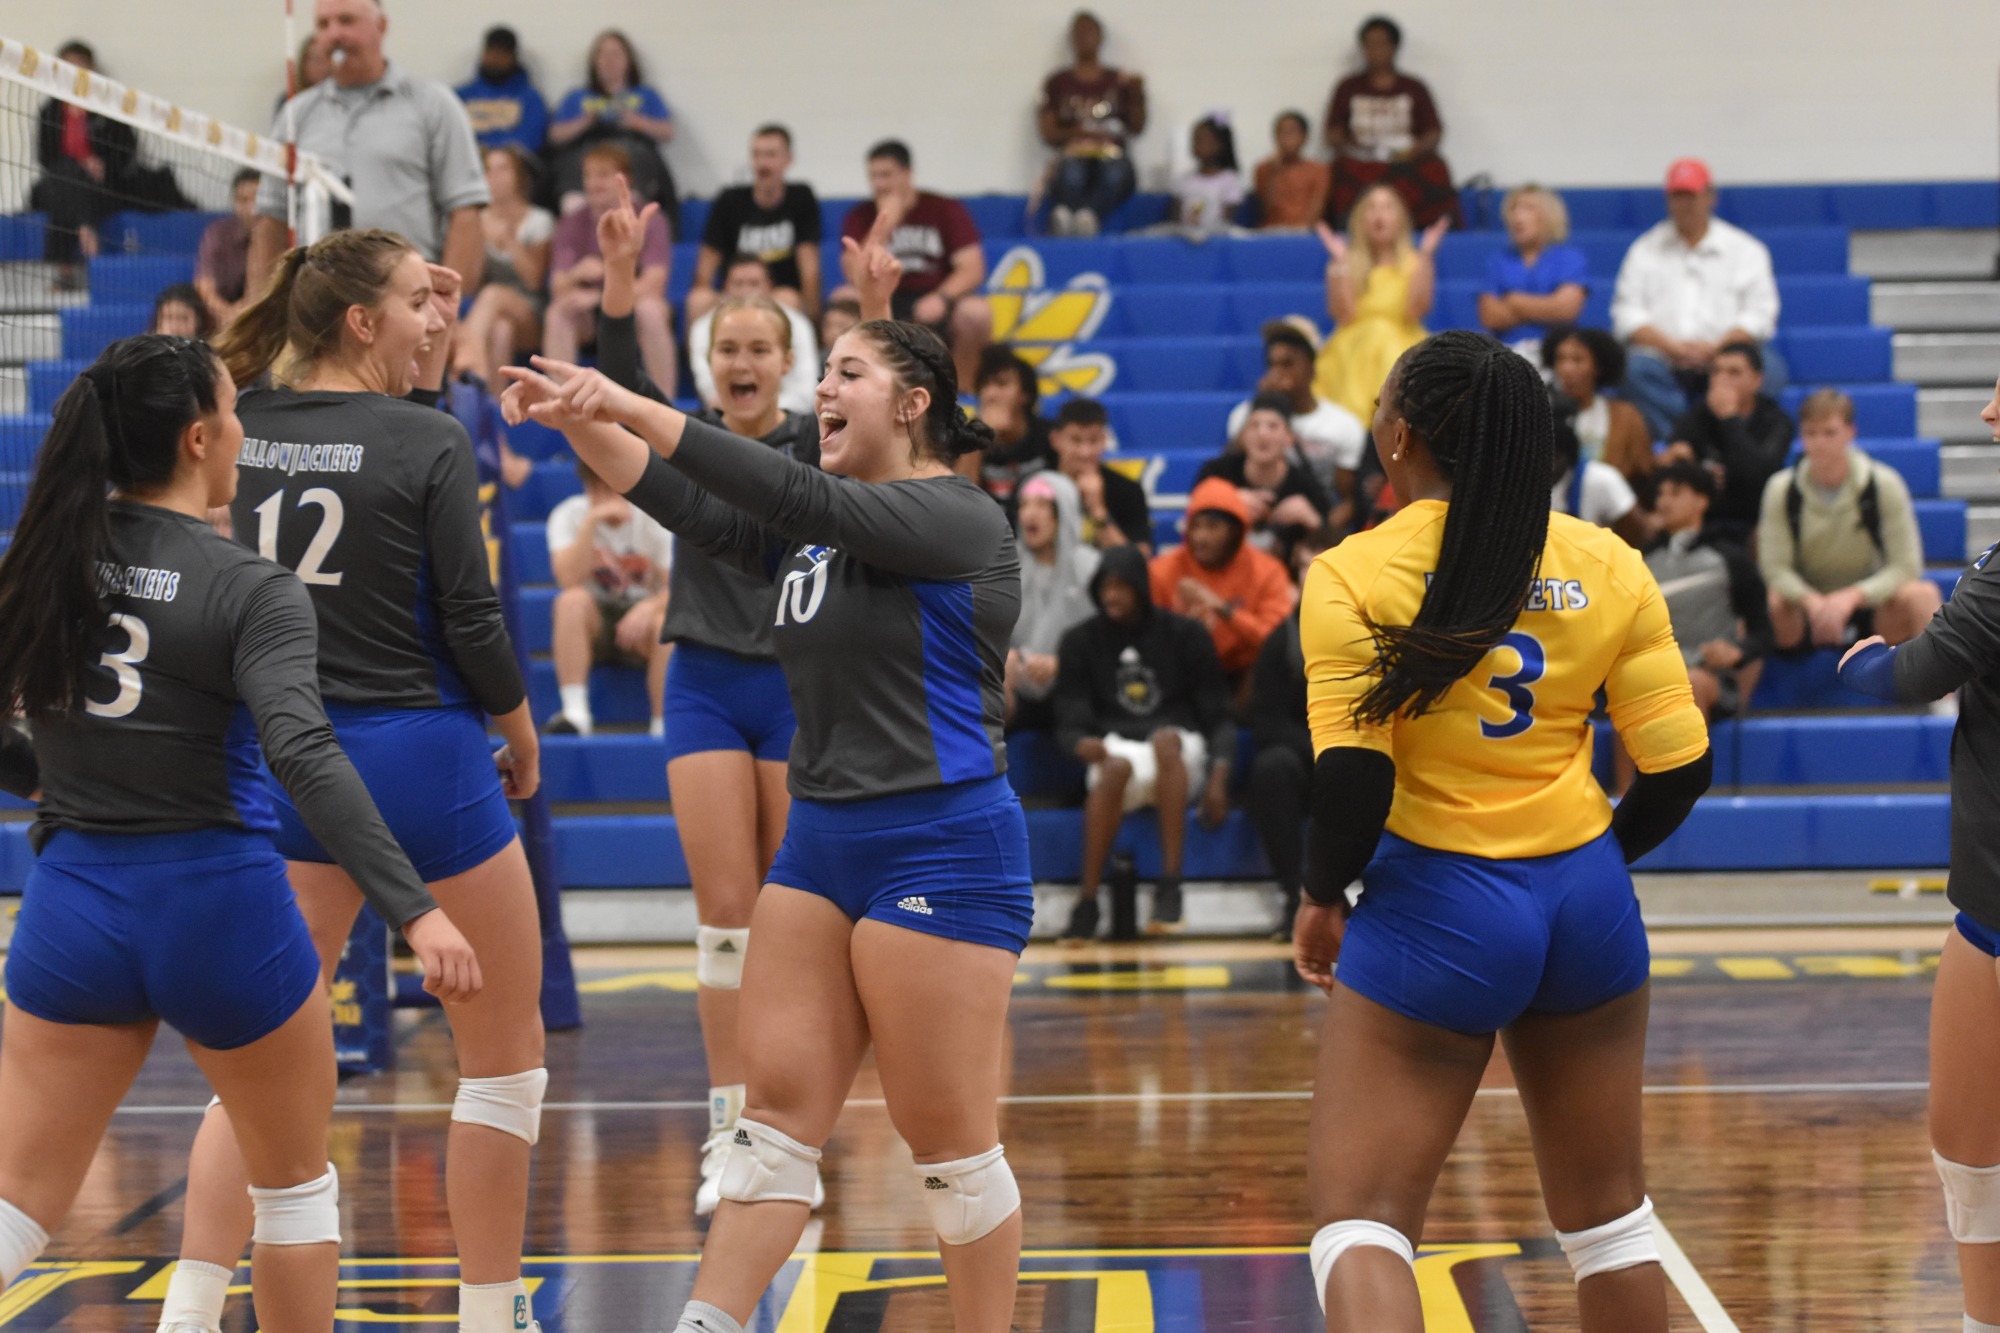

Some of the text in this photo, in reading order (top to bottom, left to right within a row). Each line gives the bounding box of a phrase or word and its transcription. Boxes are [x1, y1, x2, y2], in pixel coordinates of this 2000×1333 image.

[253, 487, 344, 585] 12
[84, 612, 150, 718] 3
[1479, 631, 1546, 739] 3
[897, 901, 933, 915] adidas
